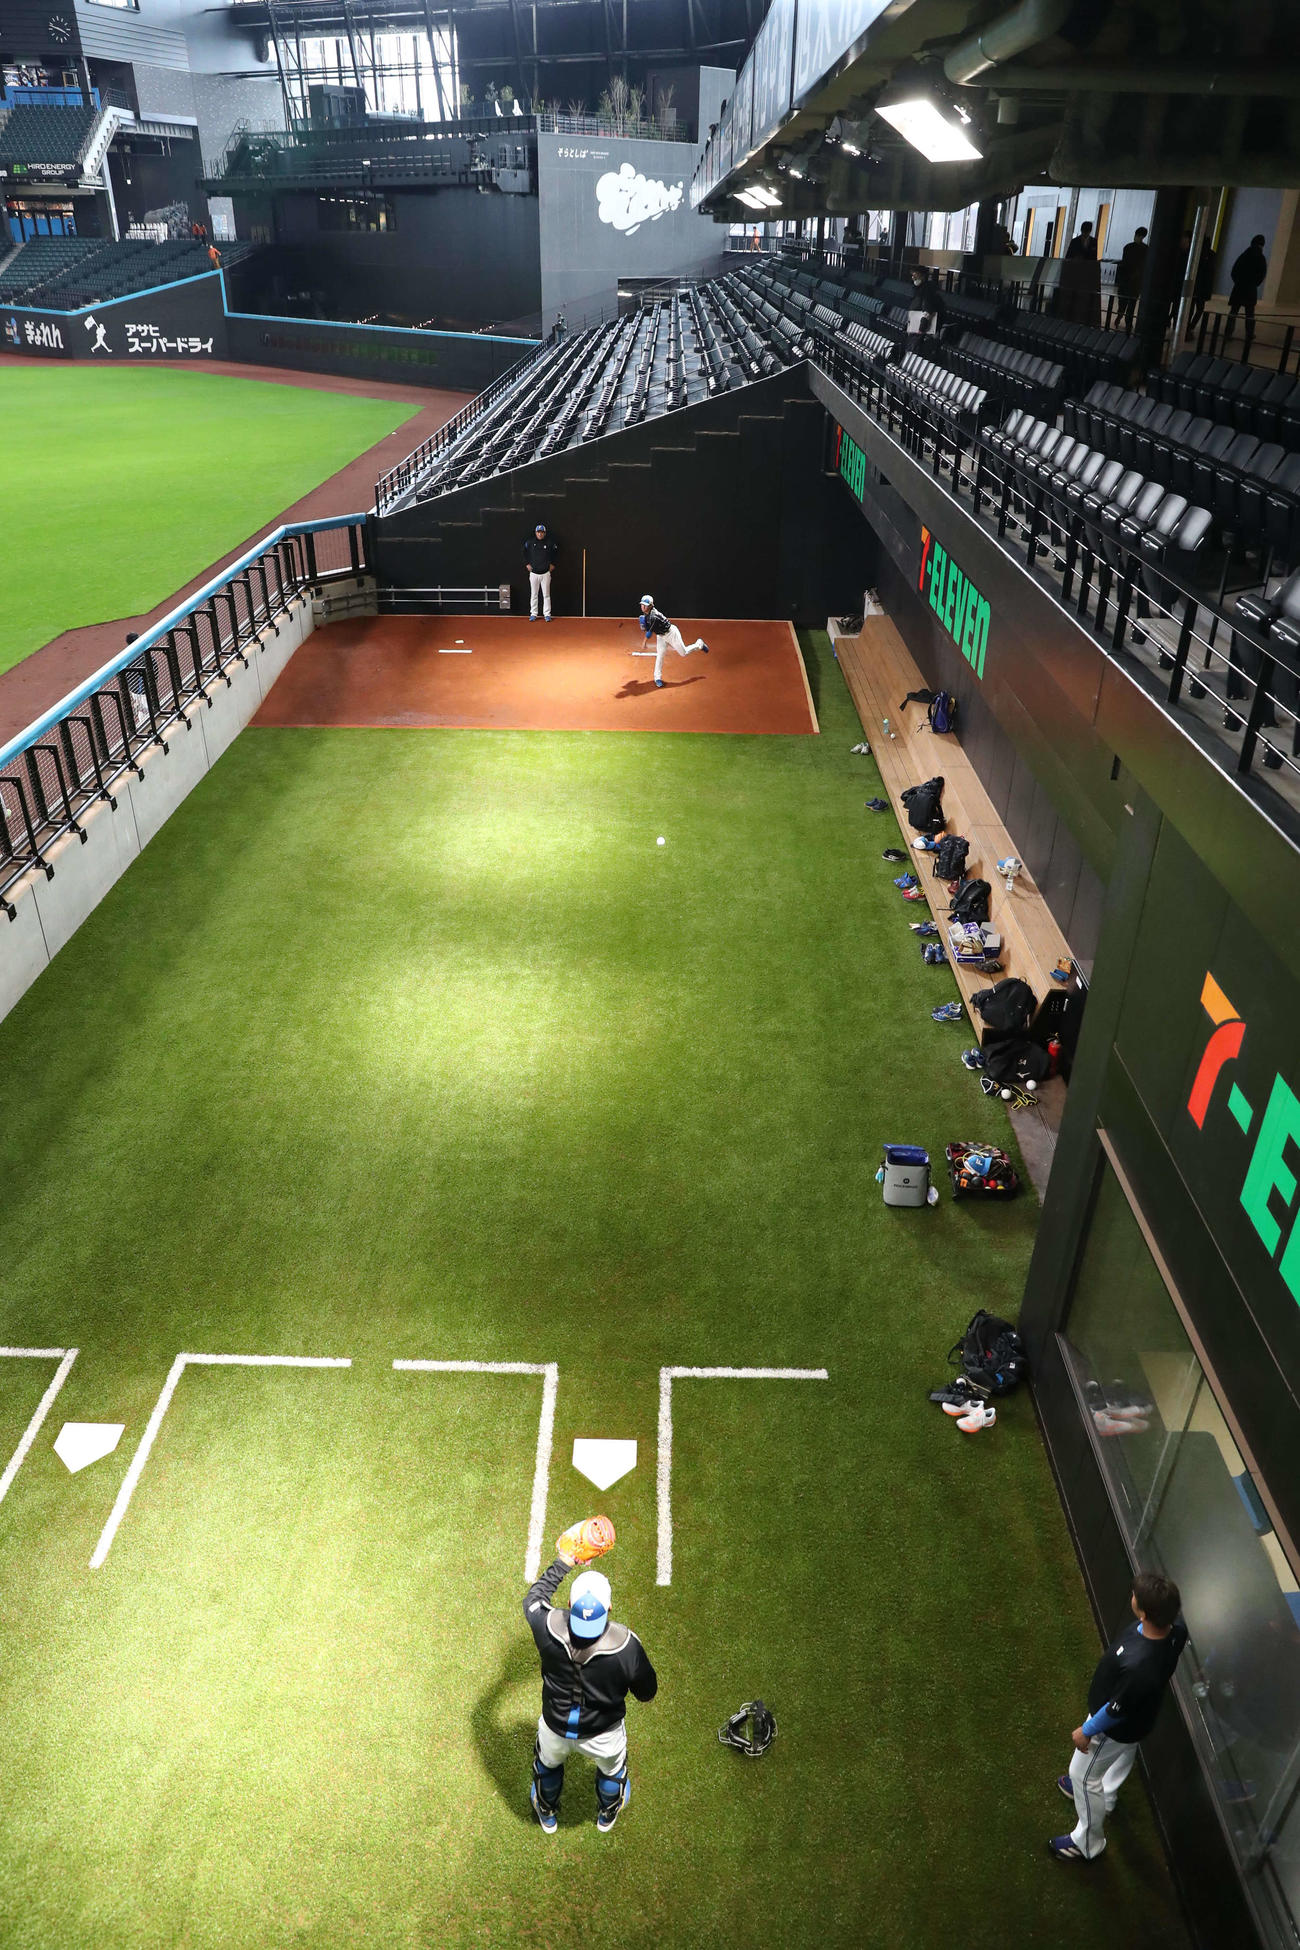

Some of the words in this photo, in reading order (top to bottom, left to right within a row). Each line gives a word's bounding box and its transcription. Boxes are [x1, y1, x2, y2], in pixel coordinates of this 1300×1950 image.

[24, 321, 64, 349] ぎょれん
[124, 324, 160, 336] アサヒ
[128, 338, 213, 353] スーパードライ
